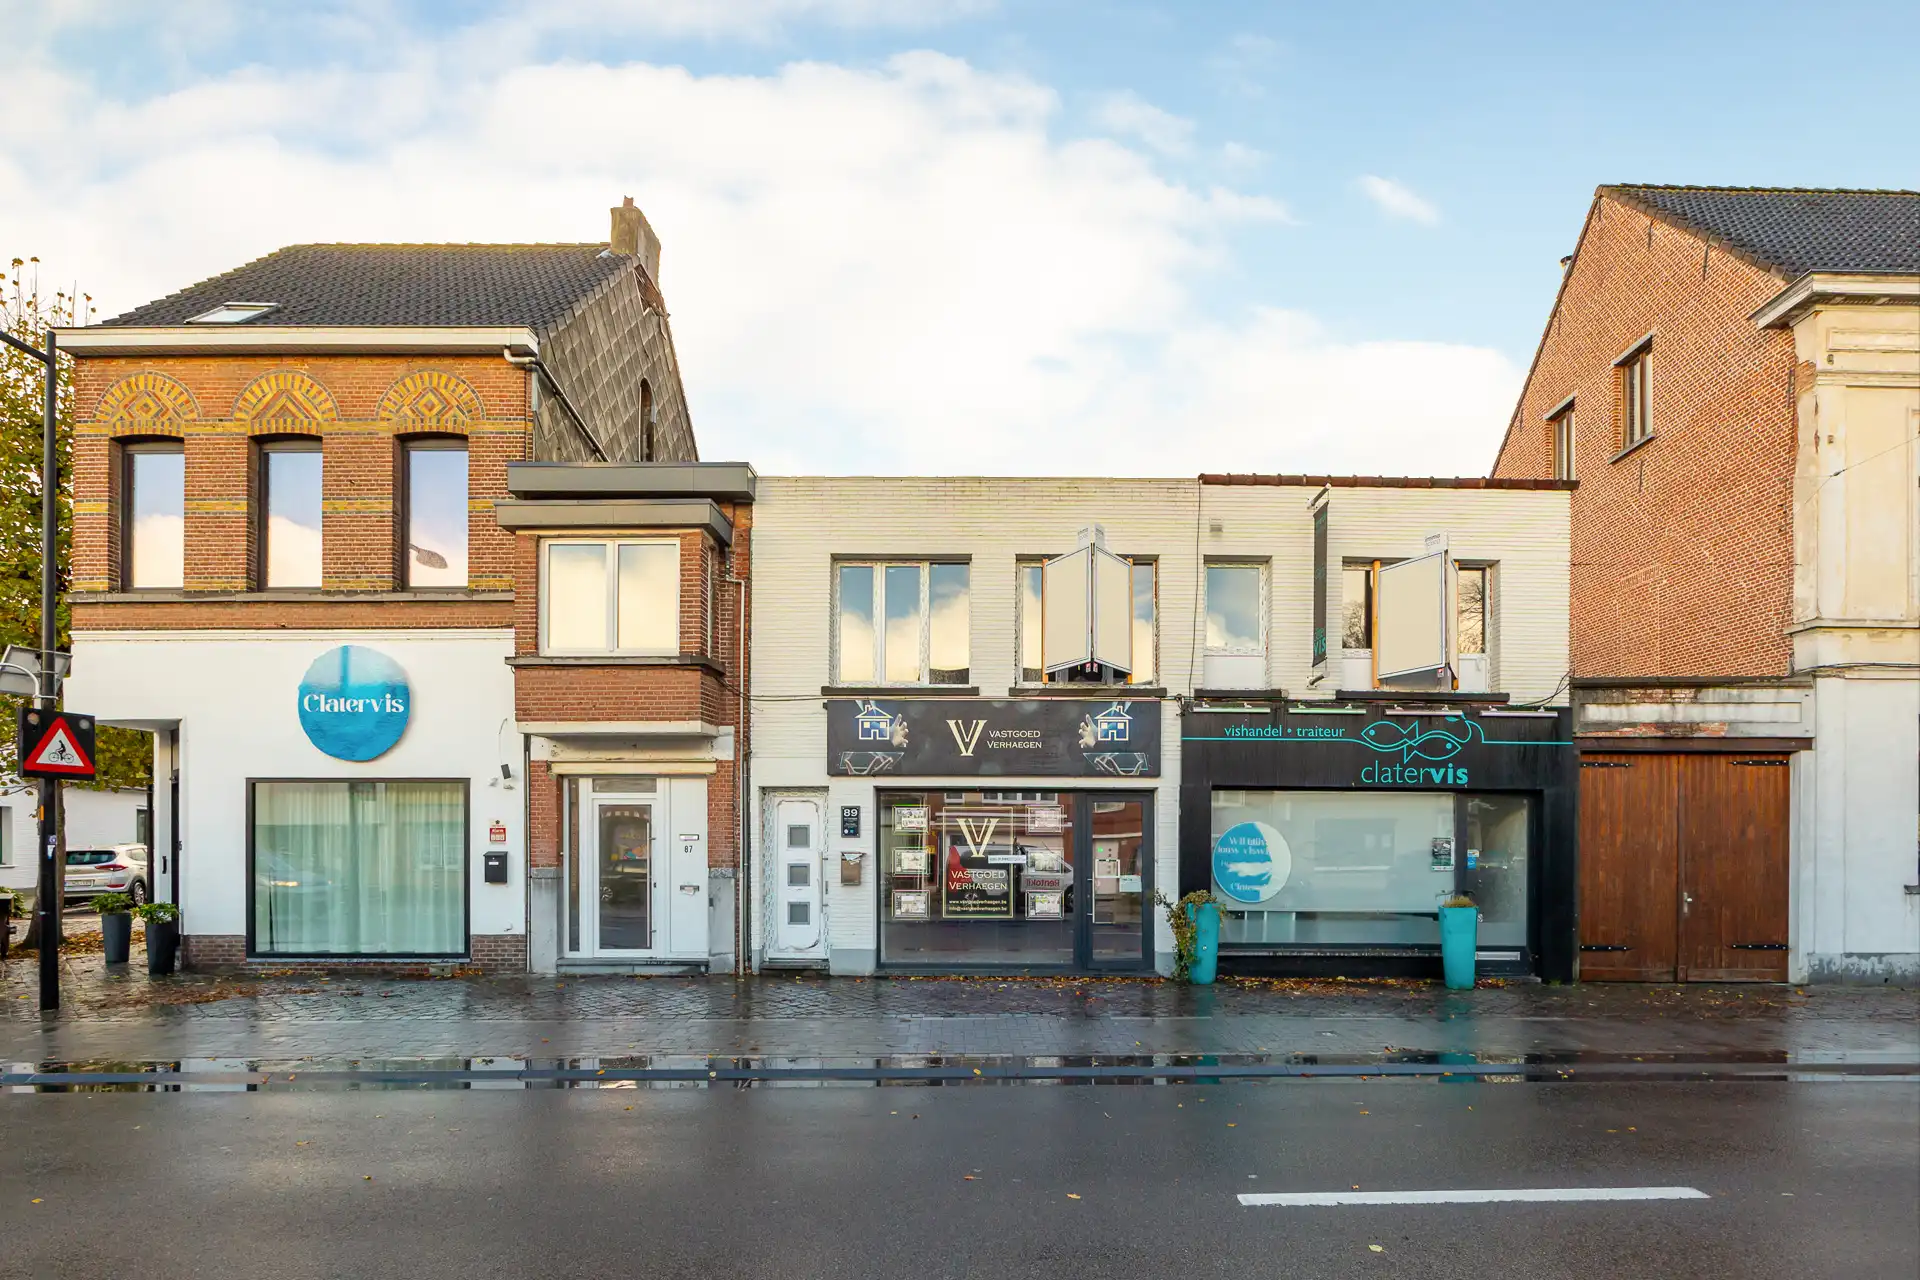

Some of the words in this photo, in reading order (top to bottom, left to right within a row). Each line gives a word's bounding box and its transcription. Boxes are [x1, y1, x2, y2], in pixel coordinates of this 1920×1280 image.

[303, 693, 405, 713] Clatervis
[988, 730, 1041, 738] VASTGOED
[1224, 724, 1283, 737] vishandel
[1297, 726, 1346, 737] traiteur
[986, 740, 1042, 749] VERHAEGEN
[1361, 759, 1469, 784] clatervis
[843, 808, 858, 817] 89
[684, 845, 693, 853] 87
[951, 870, 1006, 879] VASTGOED
[949, 881, 1008, 890] VERHAEGEN
